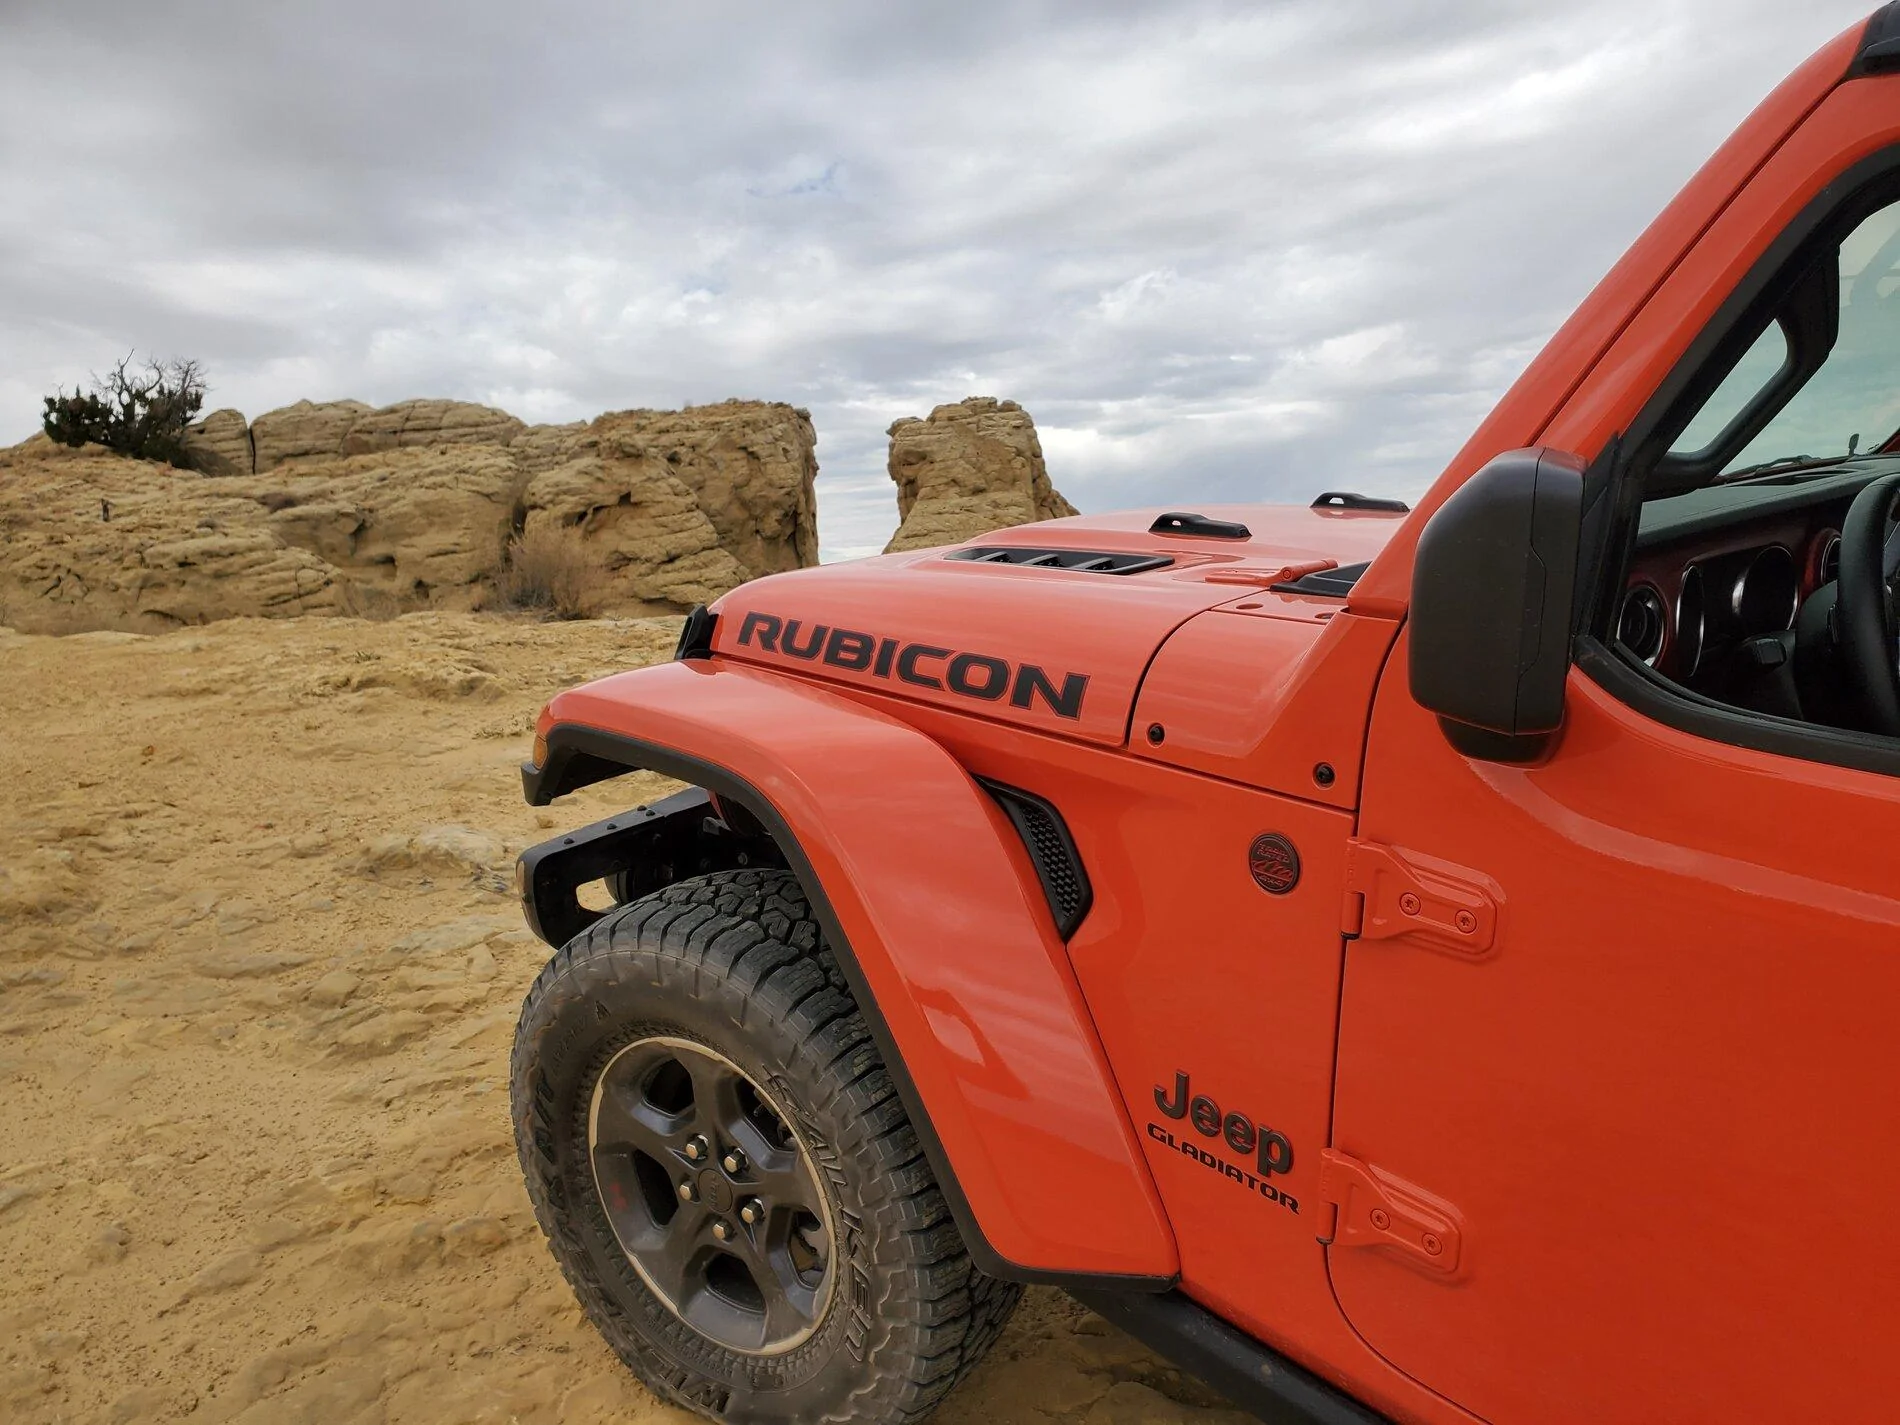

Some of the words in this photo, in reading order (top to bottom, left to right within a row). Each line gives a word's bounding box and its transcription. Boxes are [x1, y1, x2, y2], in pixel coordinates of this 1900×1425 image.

[737, 611, 1090, 720] RUBICON
[1147, 1122, 1300, 1216] GLADIATOR
[1153, 1070, 1294, 1178] Jeep
